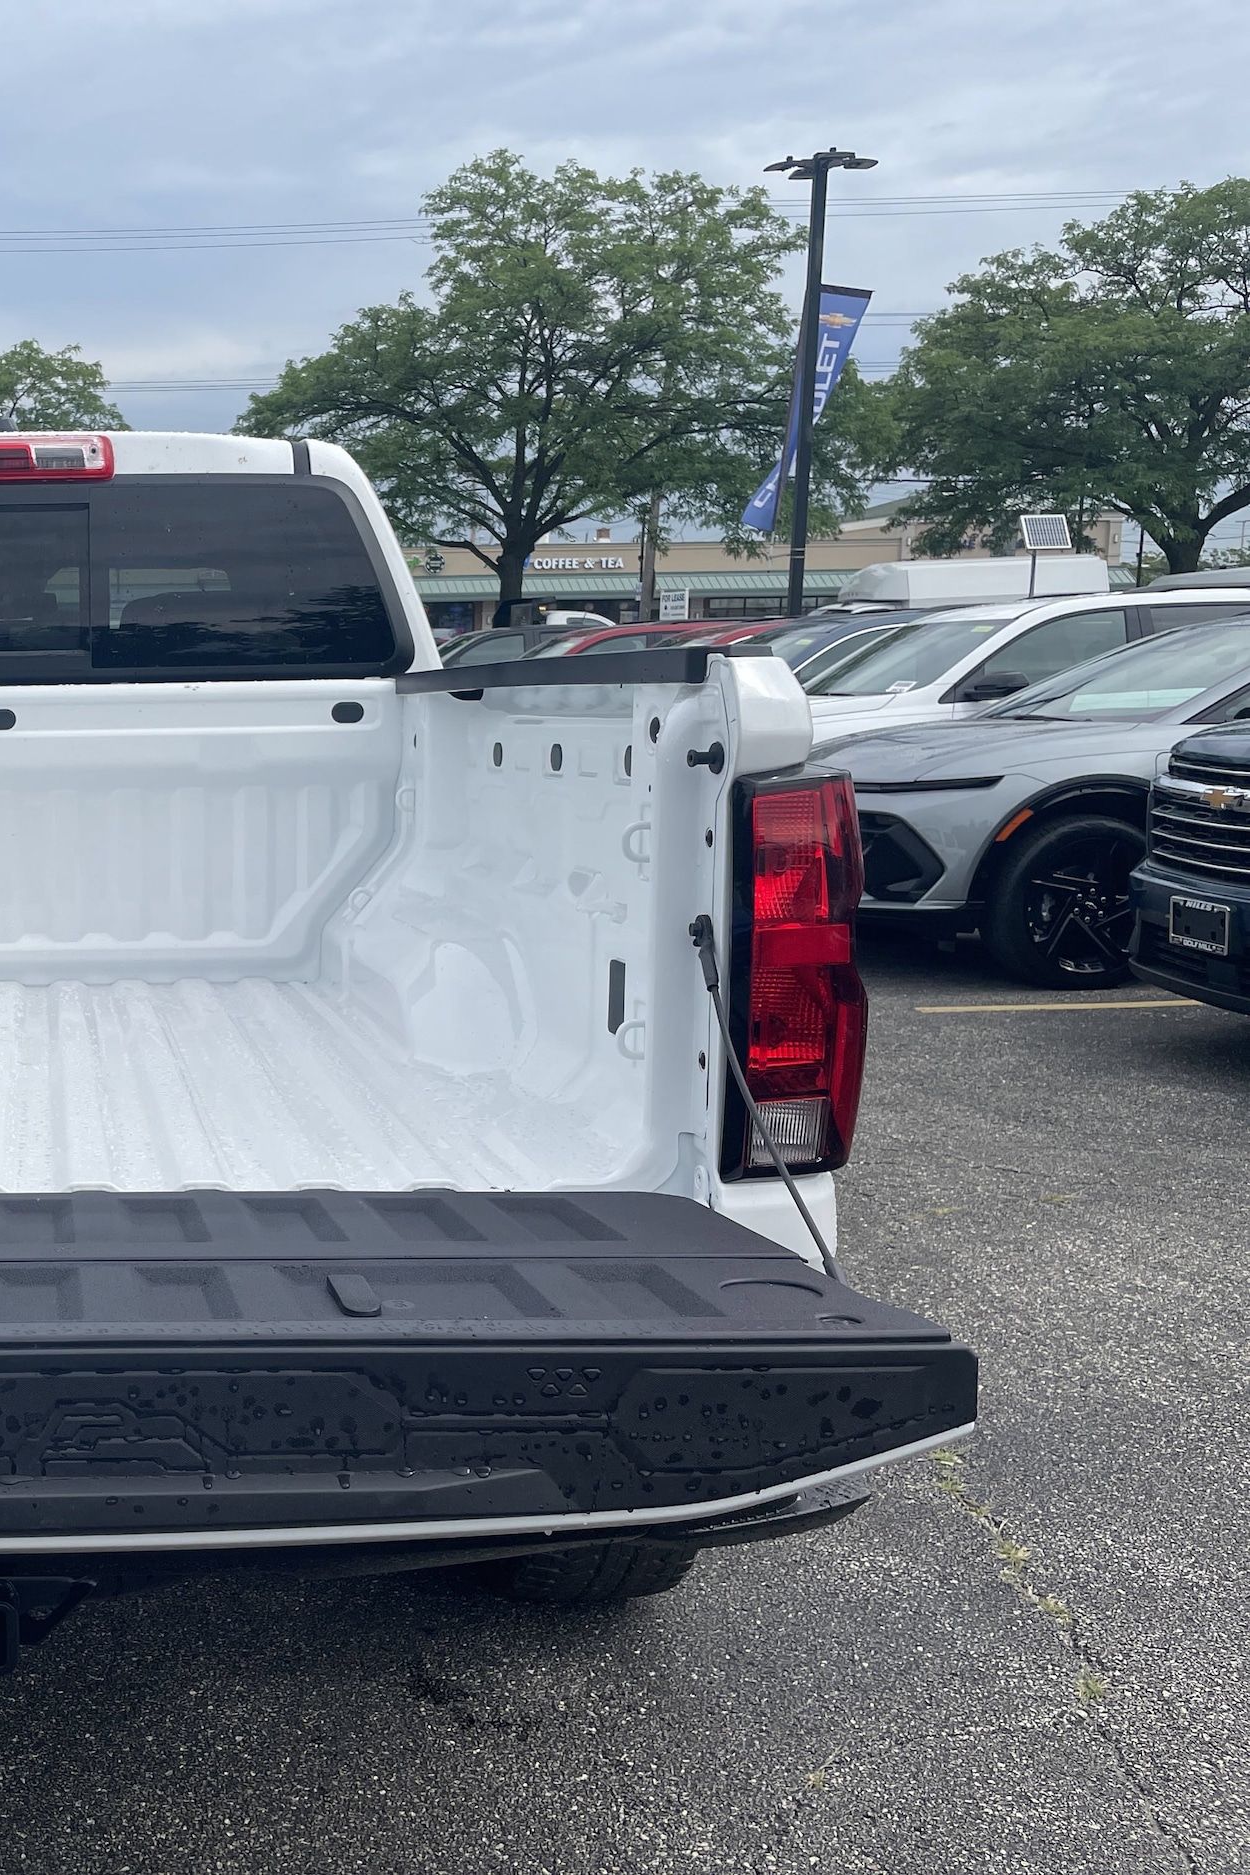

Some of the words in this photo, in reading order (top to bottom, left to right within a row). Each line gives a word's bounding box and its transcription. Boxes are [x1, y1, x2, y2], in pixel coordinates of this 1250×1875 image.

[533, 557, 579, 570] COFFEE
[584, 557, 594, 569] &
[600, 557, 624, 569] TEA
[661, 594, 671, 603] FOR
[671, 592, 685, 602] LEASE
[1185, 901, 1212, 911] NILES
[1182, 939, 1197, 948] GOLF
[1198, 942, 1213, 951] MILL
